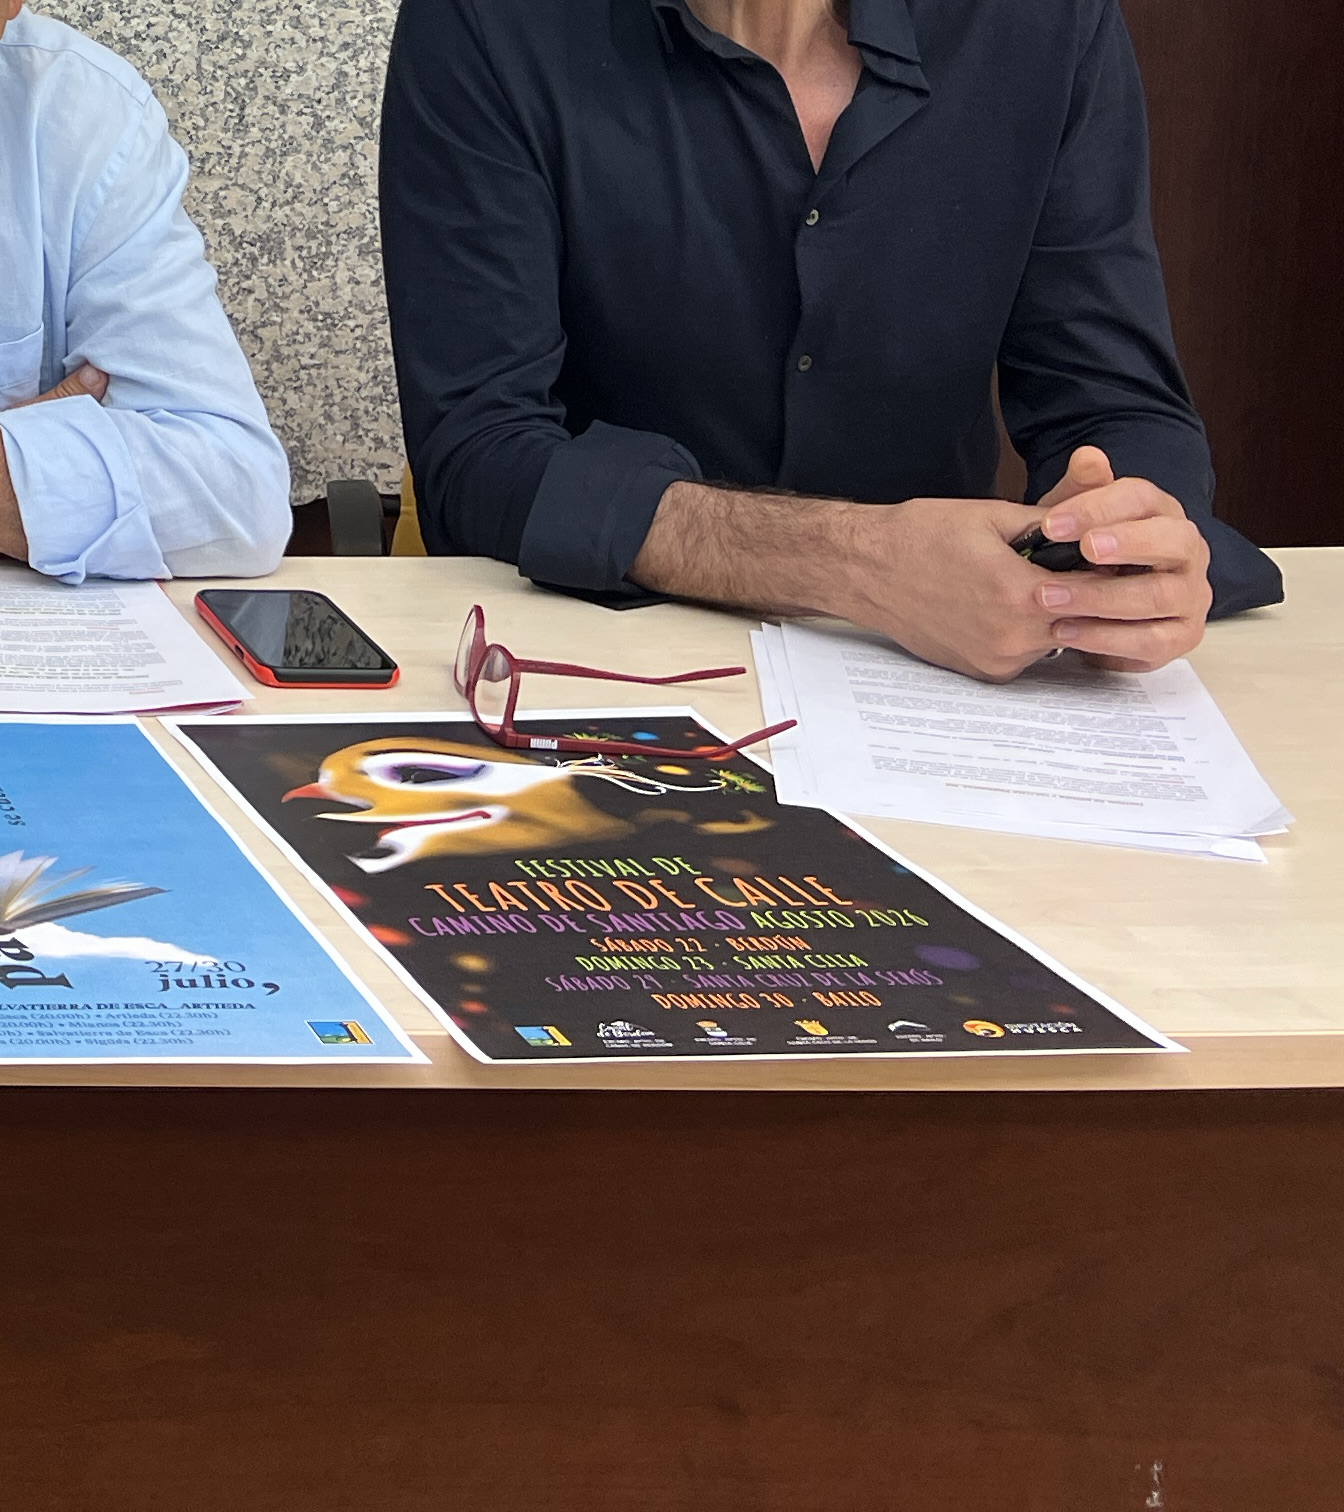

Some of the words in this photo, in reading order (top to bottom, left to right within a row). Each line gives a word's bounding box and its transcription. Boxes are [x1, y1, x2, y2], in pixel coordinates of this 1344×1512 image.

[4, 813, 26, 827] se
[514, 858, 656, 879] FESTIVAL
[652, 857, 702, 877] DE
[424, 879, 612, 913] TEATRO
[612, 879, 696, 910] DE
[694, 876, 854, 908] CALLE
[408, 913, 538, 937] CAMINO
[537, 913, 588, 934] DE
[586, 910, 747, 933] SANTIAGO
[750, 910, 855, 930] AGOSTO
[854, 909, 930, 928] 2026
[590, 936, 674, 953] SÁBADO
[675, 937, 708, 952] 22
[725, 934, 812, 951] BERDÚN
[145, 960, 246, 973] 27/30
[575, 956, 681, 972] DOMINGO
[681, 956, 715, 971] 23
[733, 954, 809, 970] SANTA
[804, 953, 869, 968] CILIA
[545, 974, 632, 992] SÁBADO
[682, 973, 755, 989] SANTA
[754, 972, 812, 989] CRUZ
[811, 972, 847, 987] DE
[851, 971, 877, 986] LA
[96, 1002, 120, 1010] DE
[651, 992, 761, 1010] DOMINGO
[759, 992, 795, 1008] 30
[812, 991, 882, 1008] BAILO
